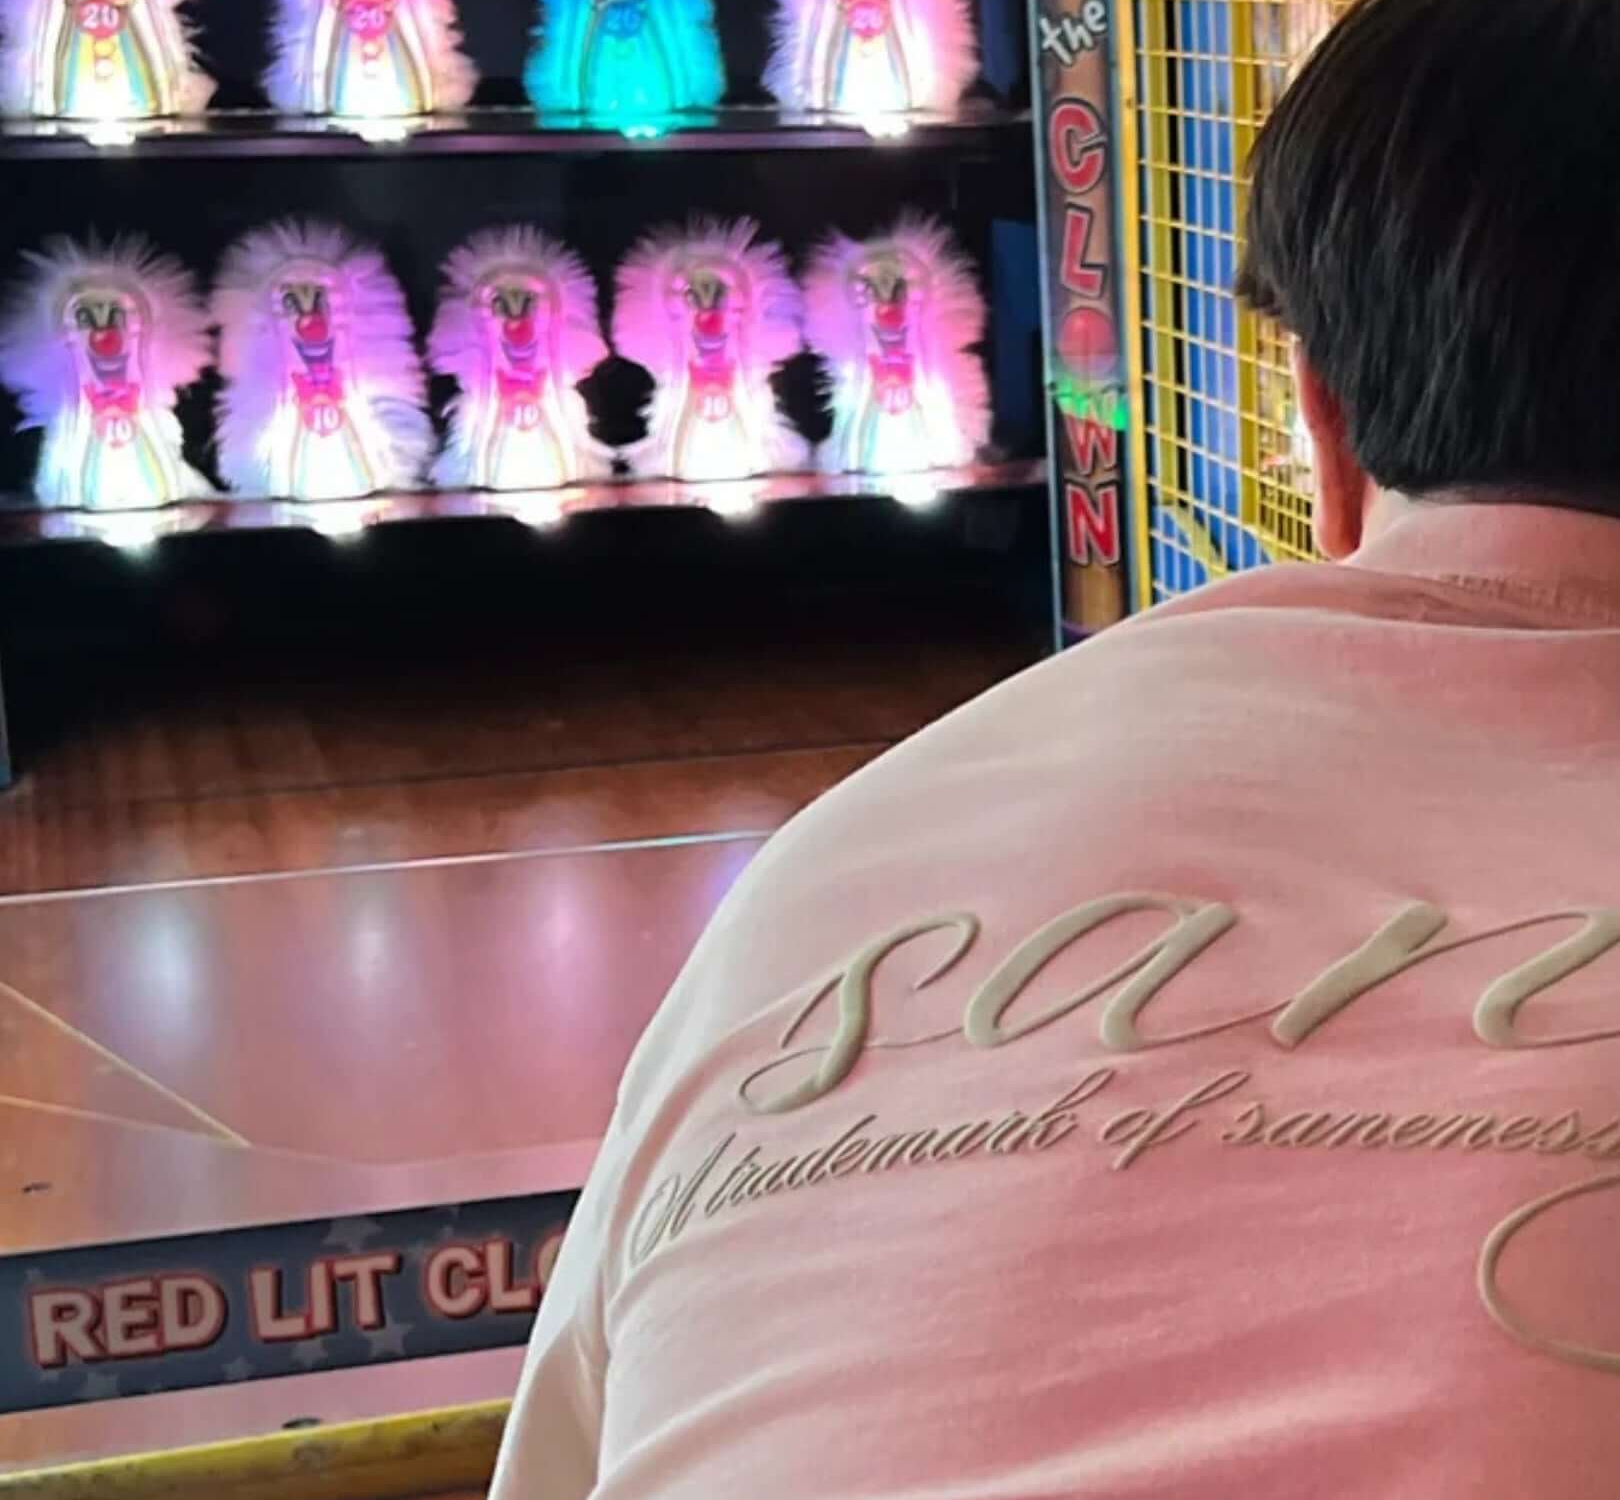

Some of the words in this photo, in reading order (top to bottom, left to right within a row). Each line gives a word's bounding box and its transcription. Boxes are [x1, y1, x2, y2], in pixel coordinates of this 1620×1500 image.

[81, 4, 119, 29] 20
[312, 407, 339, 431] 10
[706, 1068, 1115, 1219] trademark
[1098, 1070, 1250, 1171] of
[32, 1277, 226, 1367] RED
[250, 1253, 400, 1342] LIT
